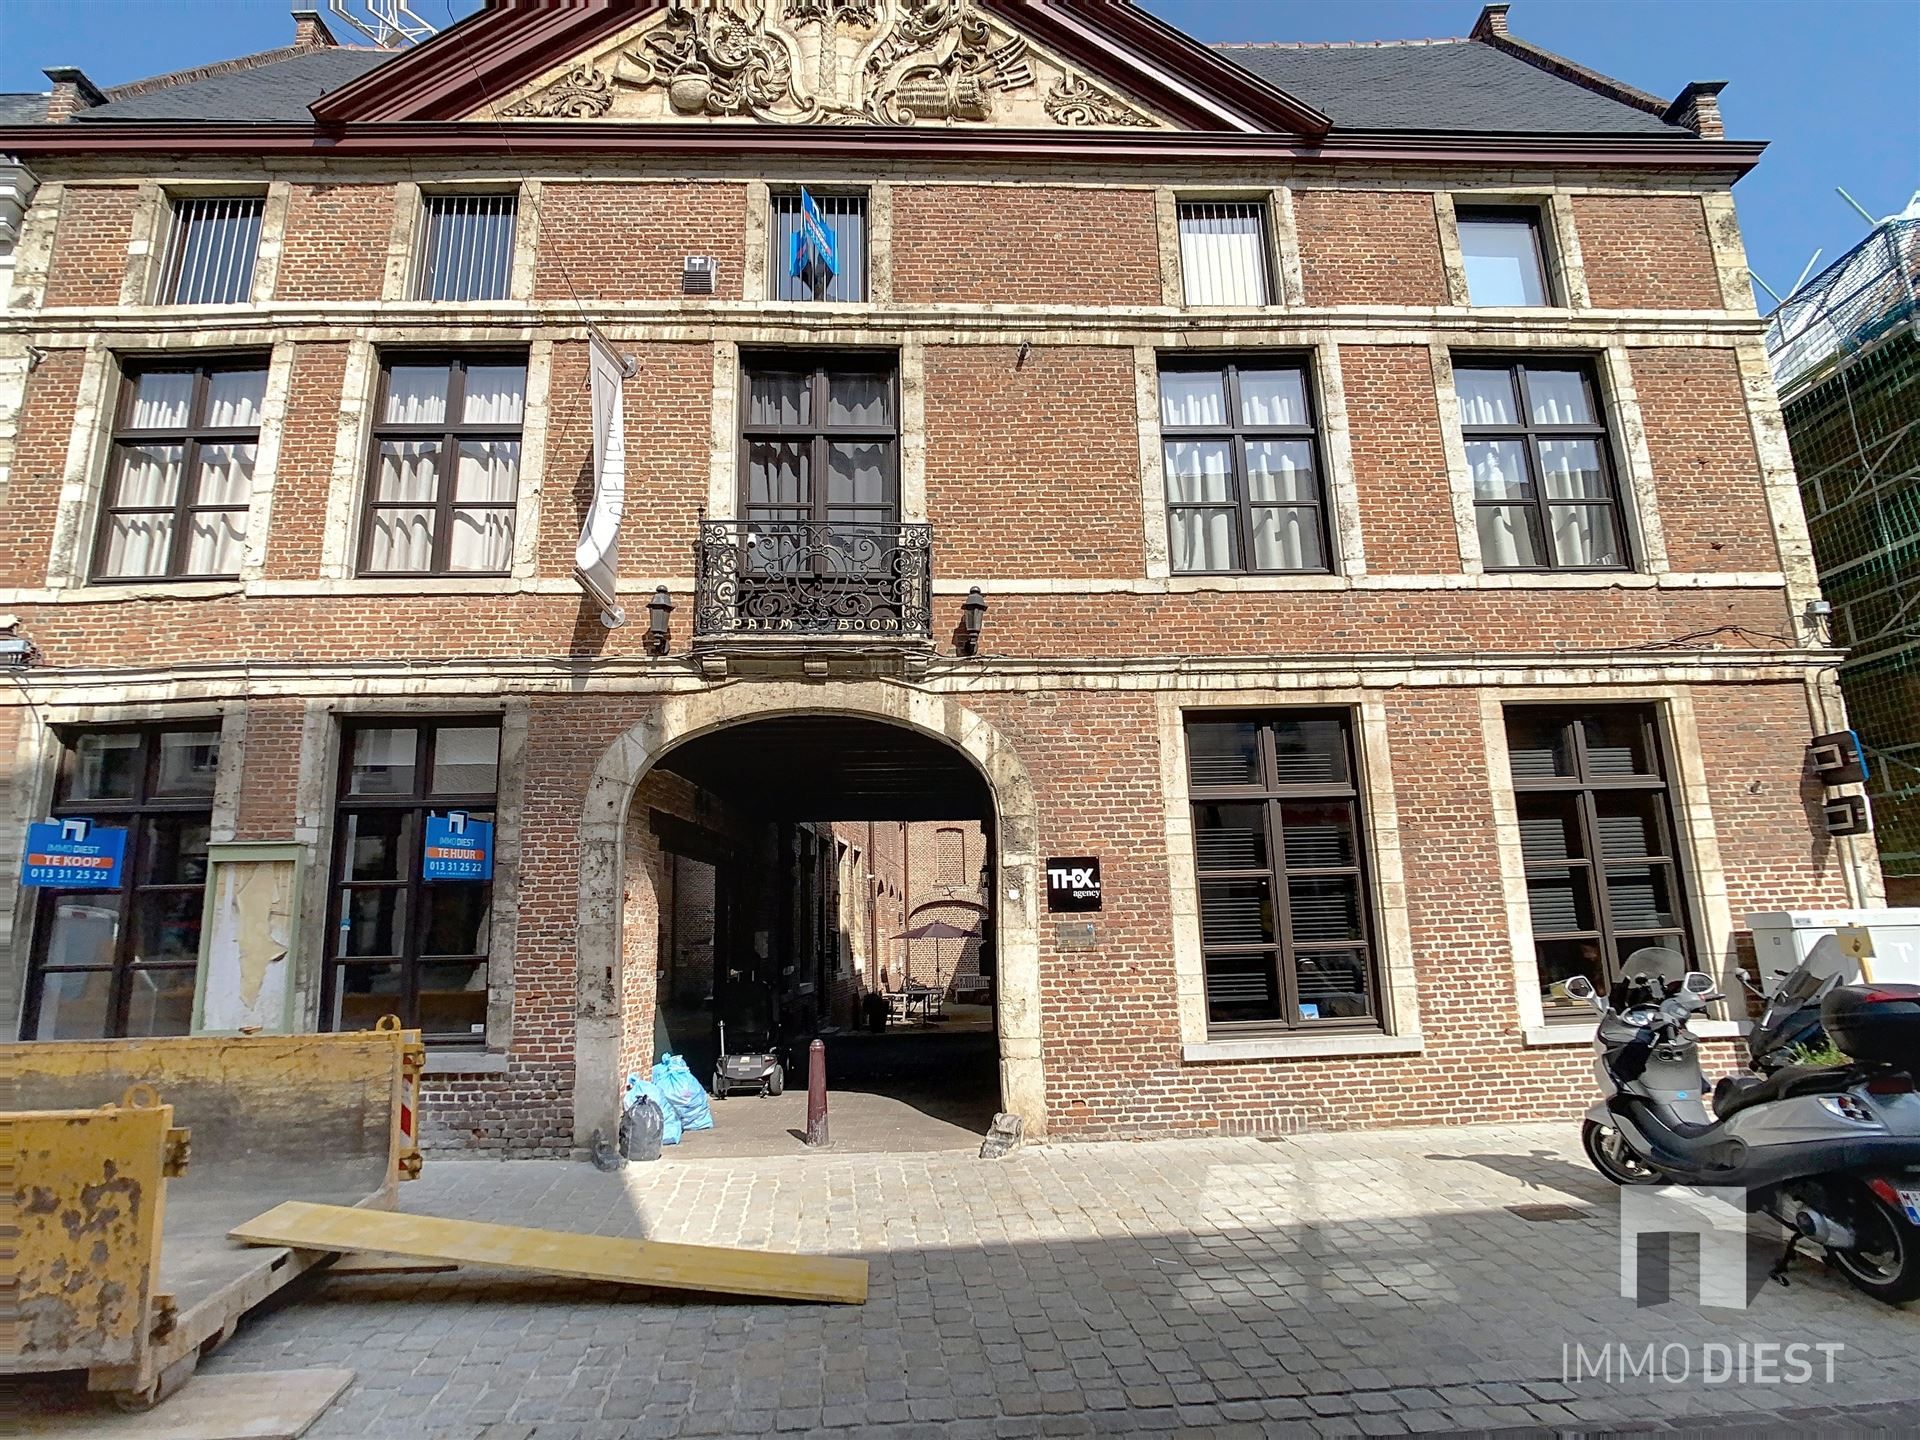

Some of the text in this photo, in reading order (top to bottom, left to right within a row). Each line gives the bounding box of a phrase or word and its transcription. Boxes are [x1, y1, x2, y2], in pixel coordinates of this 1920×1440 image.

[732, 618, 899, 631] PALM BOOM
[73, 845, 100, 854] DIEST
[438, 848, 476, 860] TE HUUR
[44, 855, 101, 868] TE KOOP
[430, 862, 482, 872] 013 31 25 22
[31, 868, 107, 880] 013 31 25 22
[1073, 890, 1100, 898] agency
